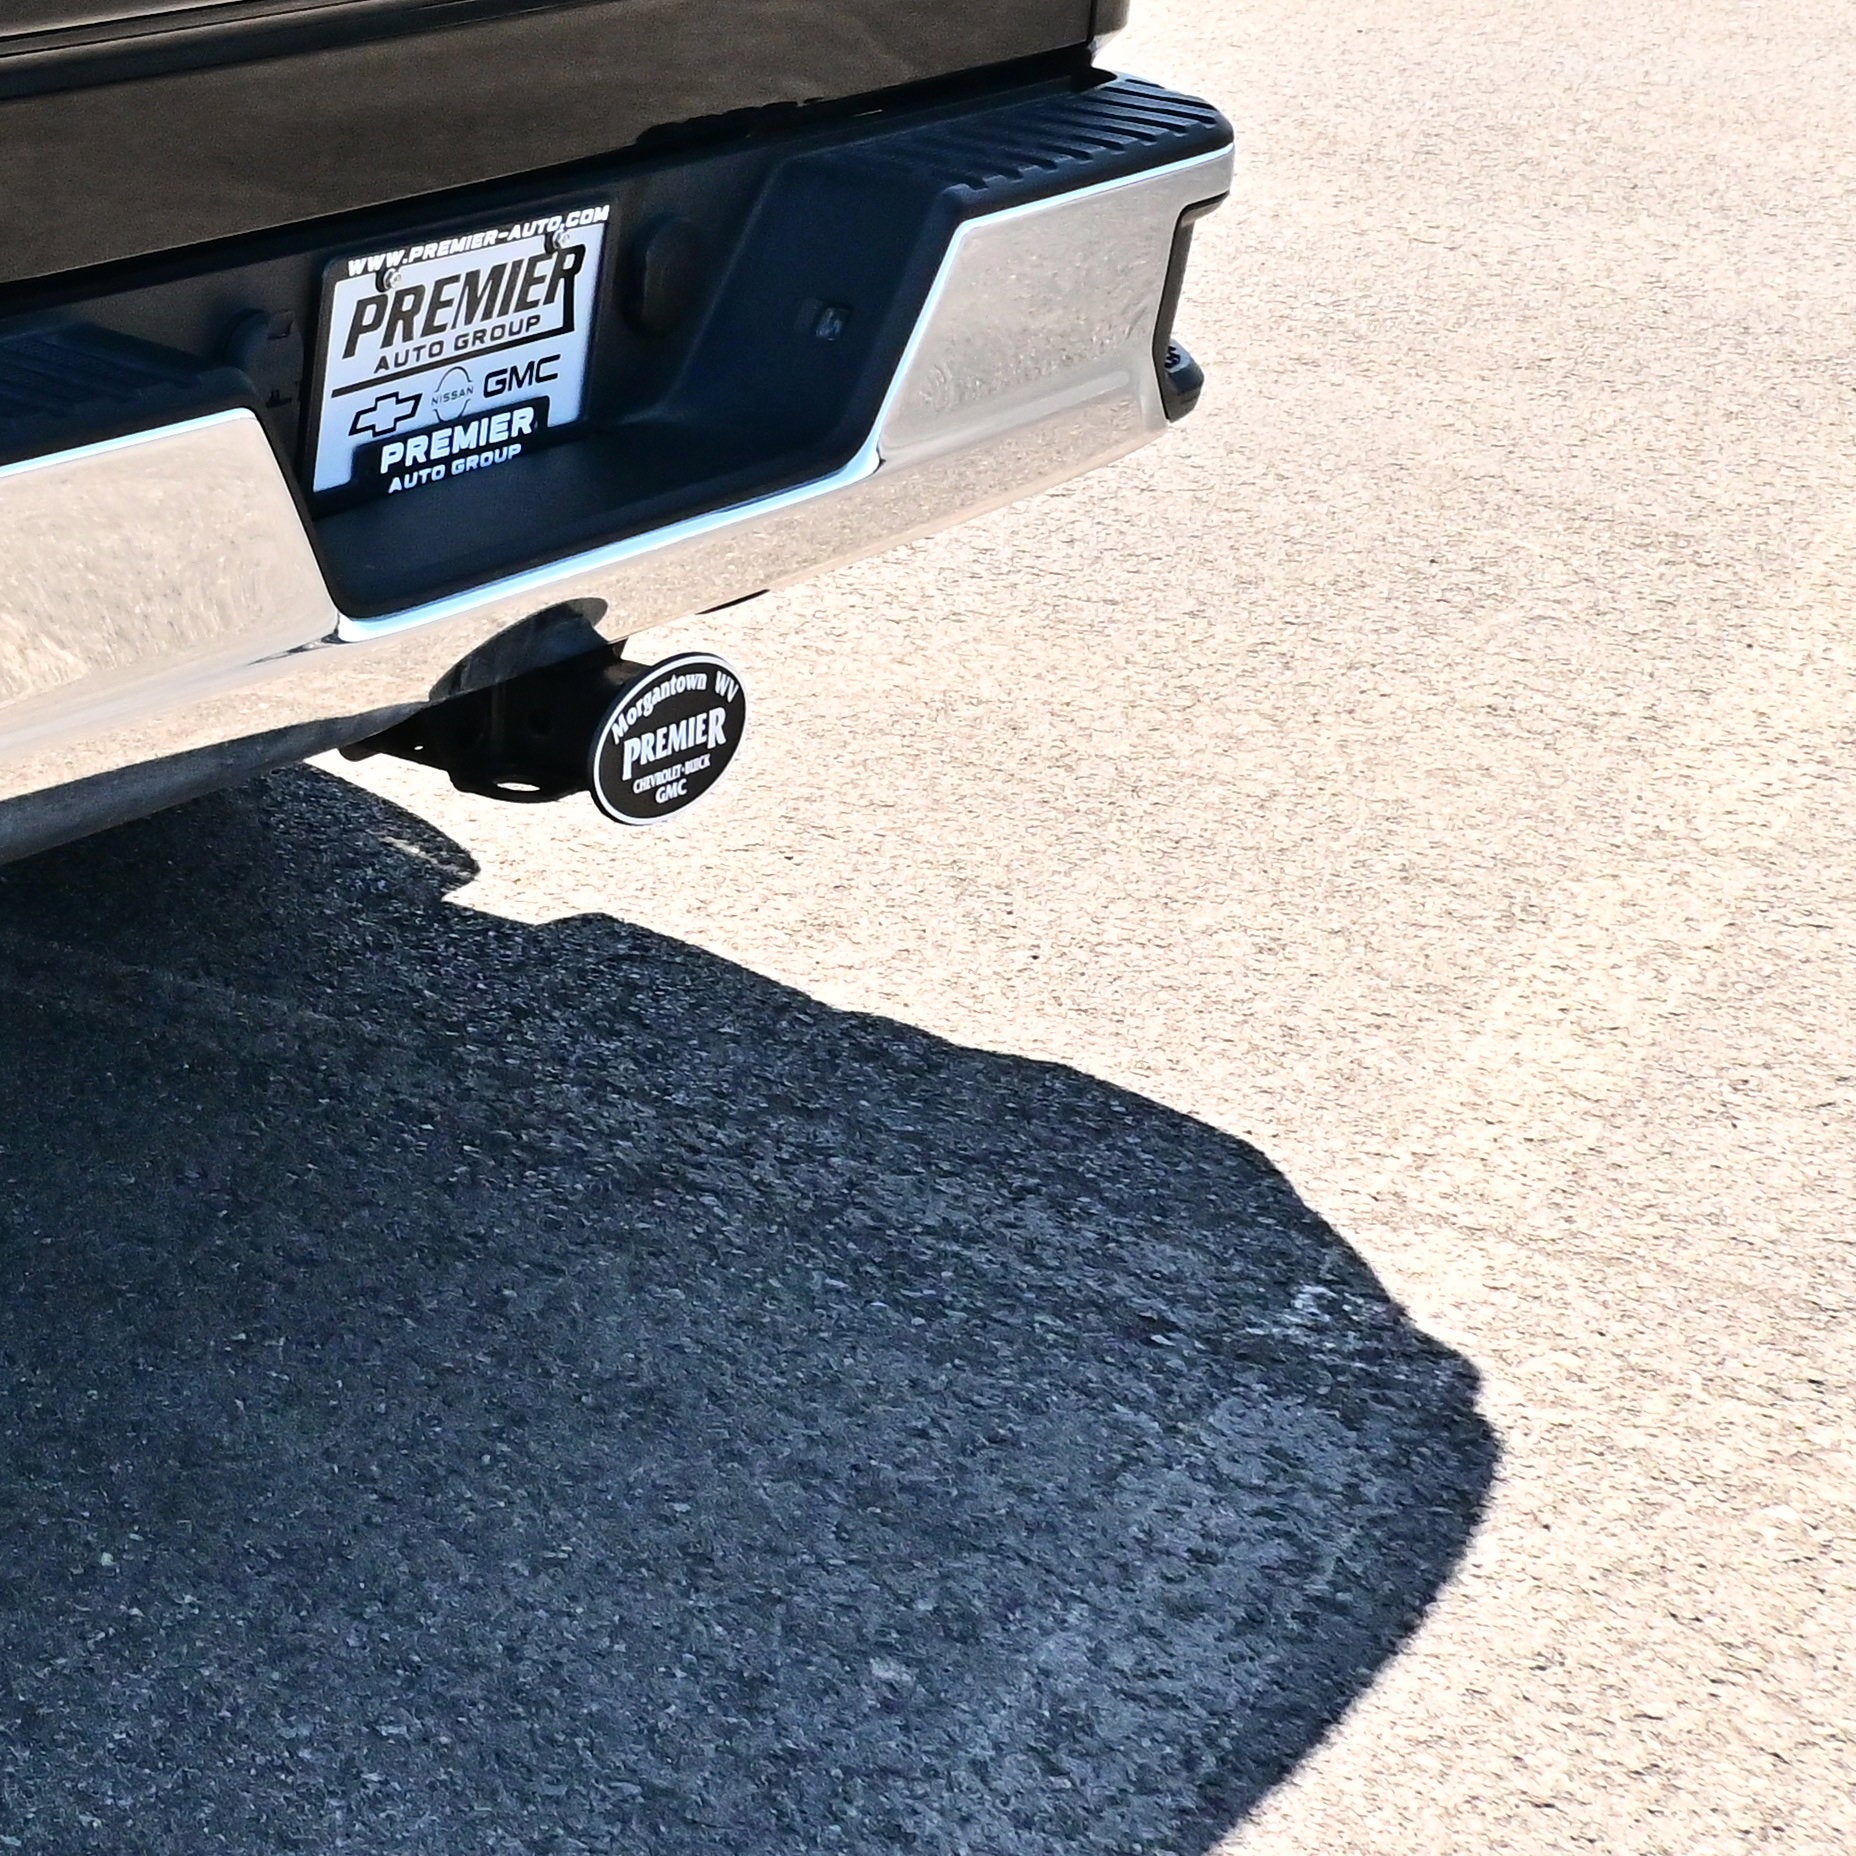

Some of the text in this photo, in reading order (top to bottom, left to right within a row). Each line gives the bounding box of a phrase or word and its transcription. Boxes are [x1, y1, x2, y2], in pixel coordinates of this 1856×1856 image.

[348, 204, 610, 277] WWW.PREMIER-AUTO.COM
[342, 243, 586, 359] PREMIER
[374, 314, 541, 374] AUTO GROUP
[431, 385, 474, 406] NISSAN
[484, 354, 561, 398] GMC
[380, 407, 536, 474] PREMIER
[388, 443, 522, 494] AUTO GROUP
[611, 671, 739, 745] Morgantown WV
[622, 707, 726, 781] PREMIER
[655, 778, 687, 804] GMC
